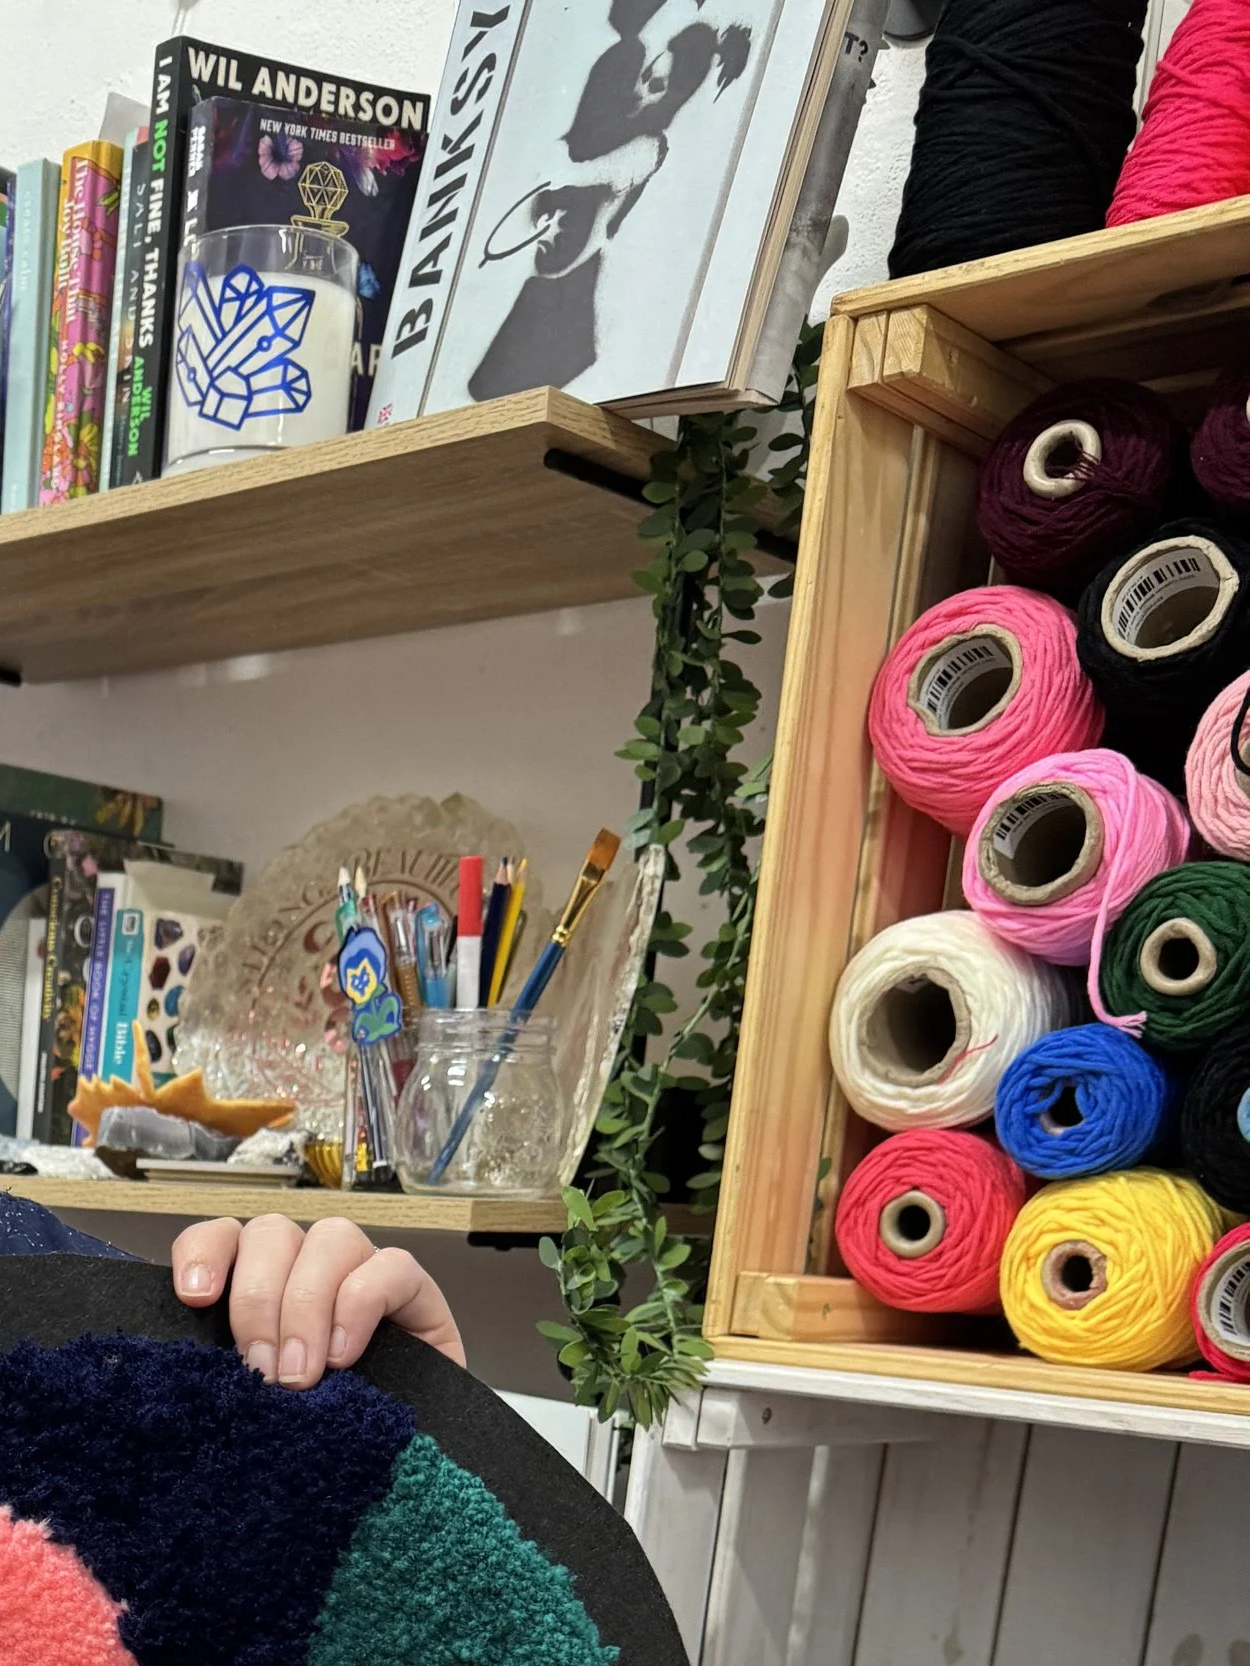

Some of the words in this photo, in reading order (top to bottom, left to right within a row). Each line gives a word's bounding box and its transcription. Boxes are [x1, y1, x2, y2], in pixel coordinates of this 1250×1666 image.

[159, 56, 173, 68] I
[154, 75, 171, 115] AM
[187, 46, 244, 92] WIL
[251, 67, 425, 132] ANDERSON
[150, 119, 169, 173] NOT
[260, 118, 282, 133] NEW
[284, 122, 309, 140] YORK
[309, 126, 338, 145] TIMES
[339, 131, 397, 152] BESTSELLER
[73, 160, 89, 198] The
[391, 4, 511, 360] BANKSY
[61, 199, 76, 234] Joy
[69, 200, 86, 271] House
[143, 179, 165, 244] FINE,
[57, 240, 72, 291] Built
[65, 276, 81, 323] That
[138, 248, 161, 349] THANKS
[127, 356, 146, 457] ANDERSON
[140, 386, 153, 421] WIL
[114, 1022, 129, 1066] Bible
